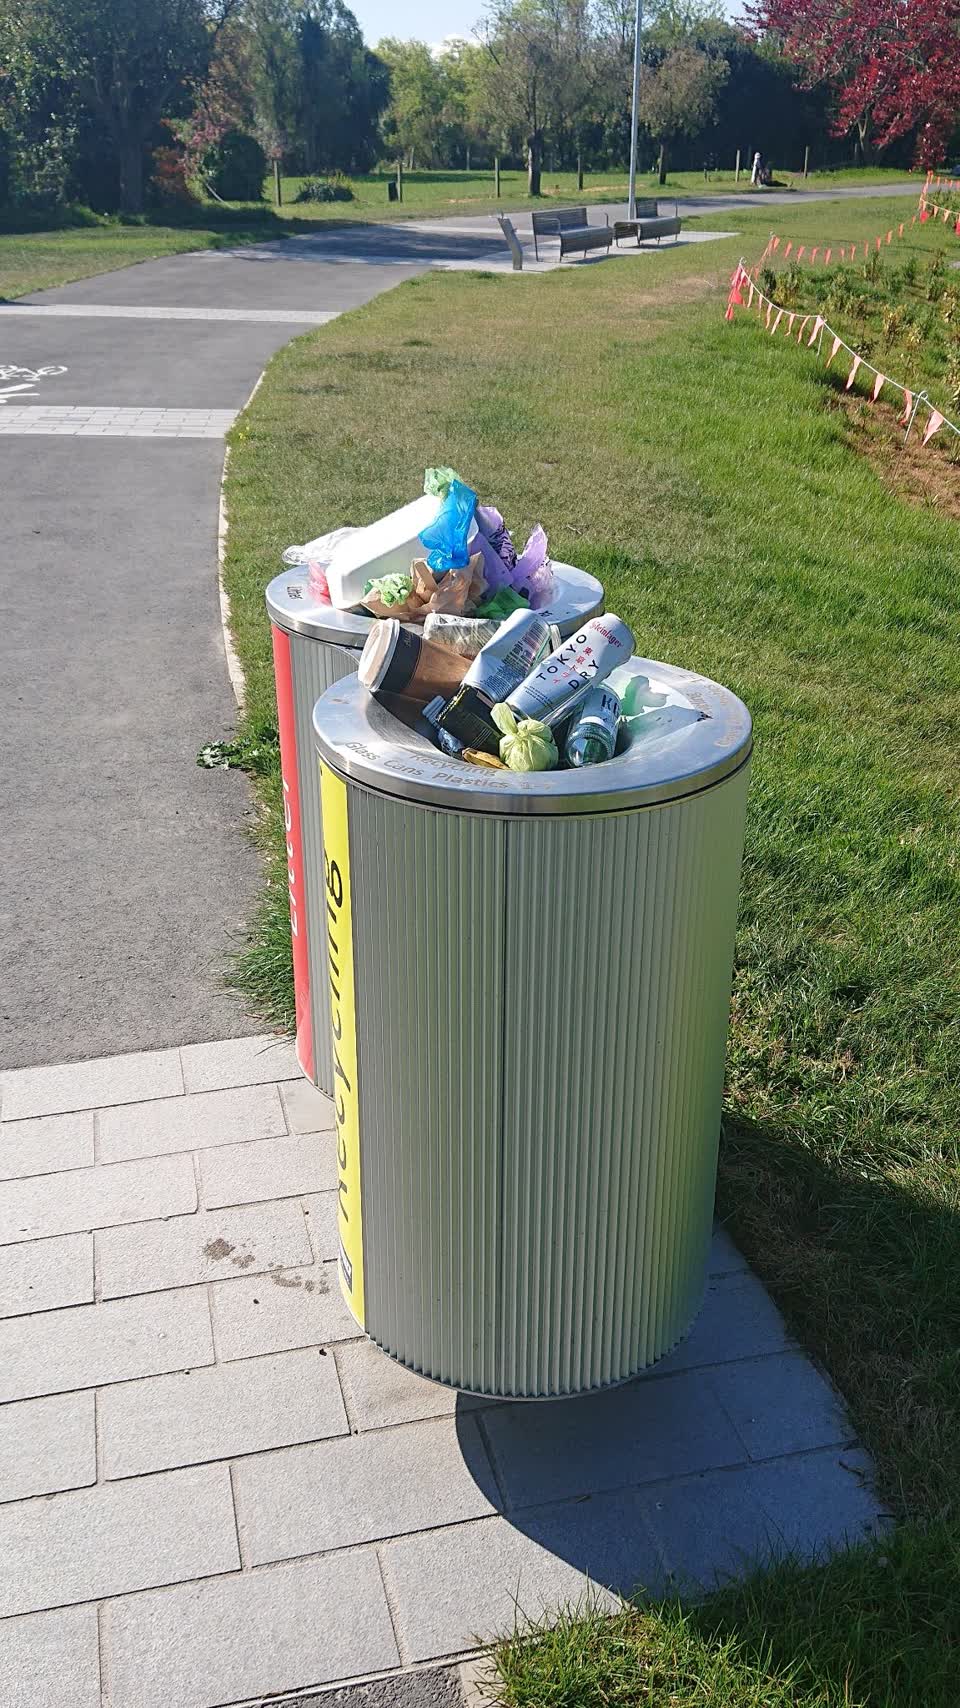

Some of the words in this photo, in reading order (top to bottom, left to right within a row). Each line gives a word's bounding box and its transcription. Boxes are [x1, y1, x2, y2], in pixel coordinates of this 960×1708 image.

[536, 634, 587, 681] TOKYO
[568, 659, 600, 690] DRY
[345, 742, 380, 760] Glass
[384, 759, 424, 777] Cans
[432, 772, 508, 789] Plastics
[410, 753, 497, 778] Recycling
